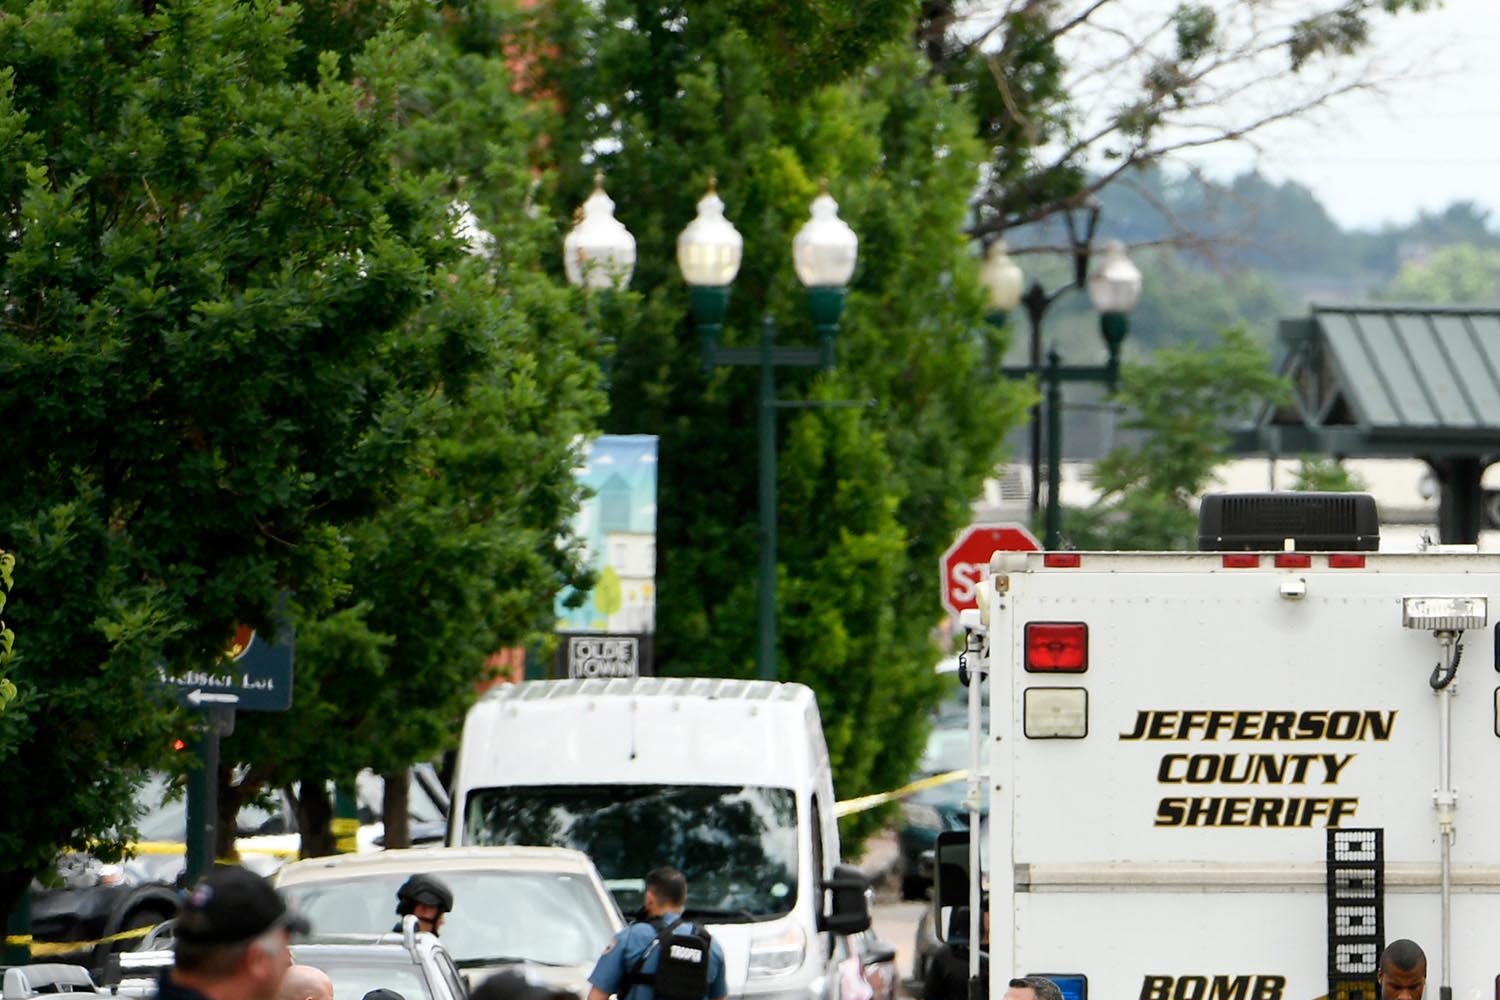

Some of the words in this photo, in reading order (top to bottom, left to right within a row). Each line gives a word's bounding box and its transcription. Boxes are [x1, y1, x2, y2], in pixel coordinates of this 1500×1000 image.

[575, 641, 633, 661] OLDE
[575, 659, 633, 678] TOWN
[1119, 710, 1399, 741] JEFFERSON
[1157, 753, 1358, 784] COUNTY
[1154, 797, 1359, 828] SHERIFF
